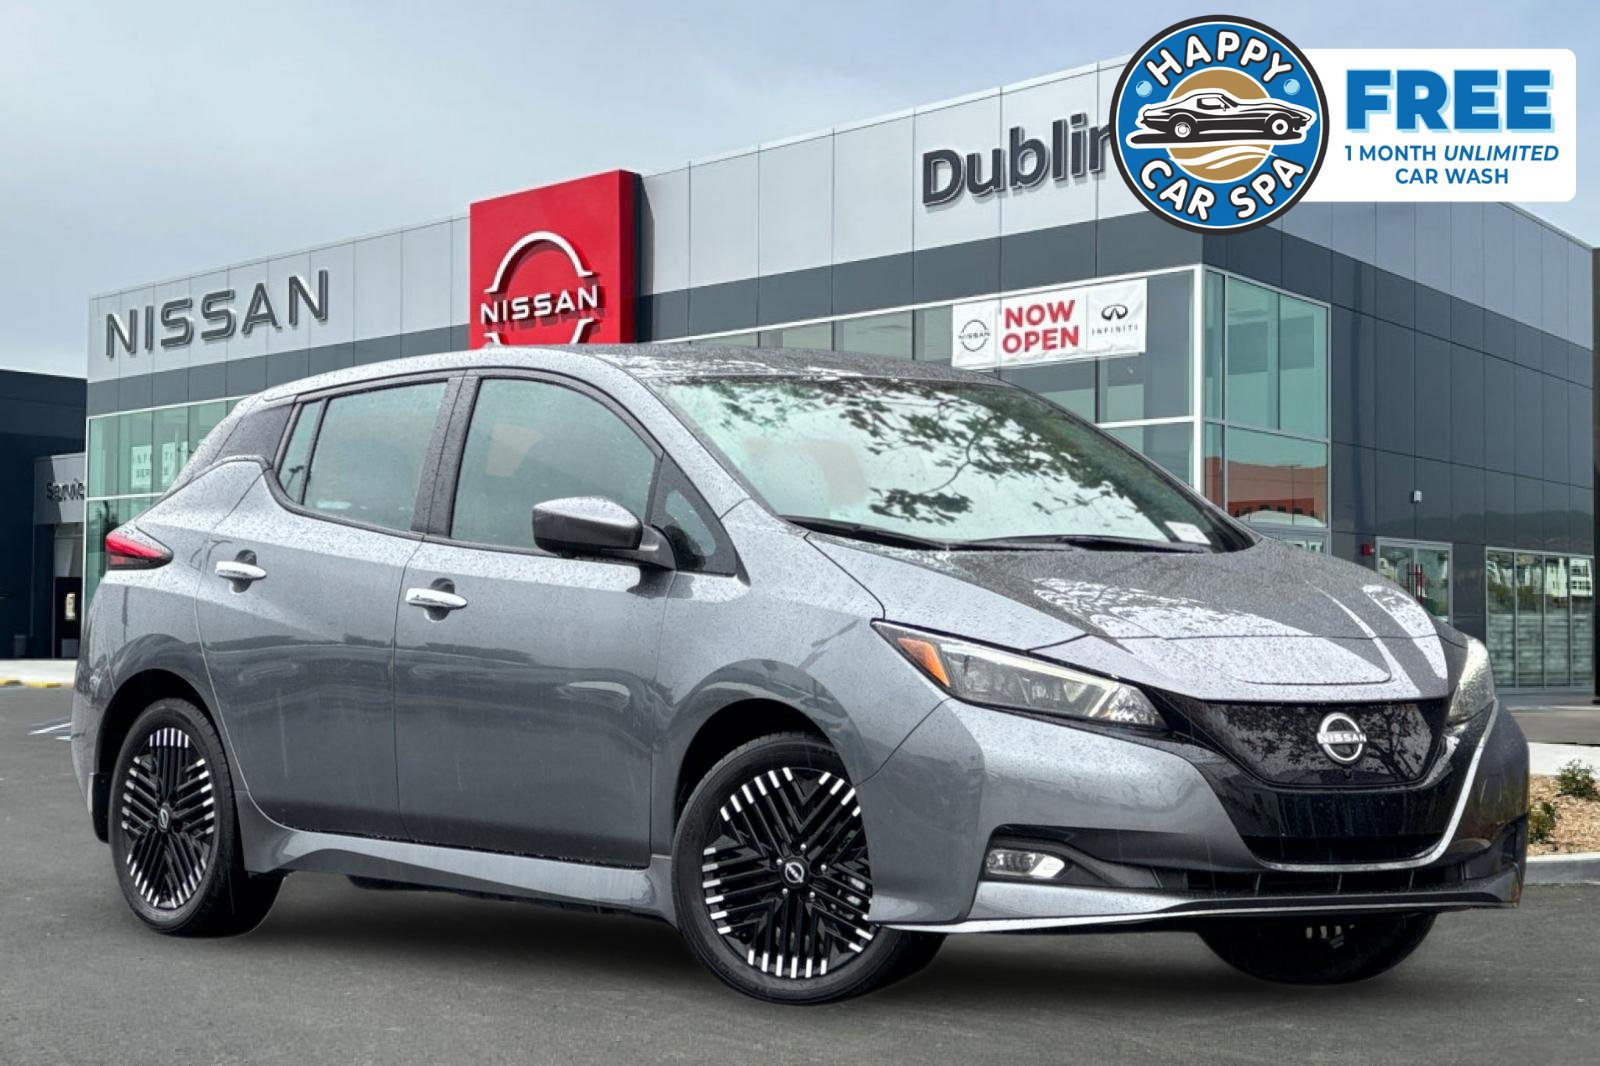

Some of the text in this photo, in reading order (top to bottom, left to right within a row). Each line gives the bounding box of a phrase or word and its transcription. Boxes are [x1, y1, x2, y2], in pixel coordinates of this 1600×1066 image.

[105, 269, 329, 358] NISSAN
[480, 285, 598, 325] NISSAN
[1004, 299, 1076, 330] NOW
[1002, 325, 1080, 354] OPEN
[1316, 732, 1367, 745] NISSAN
